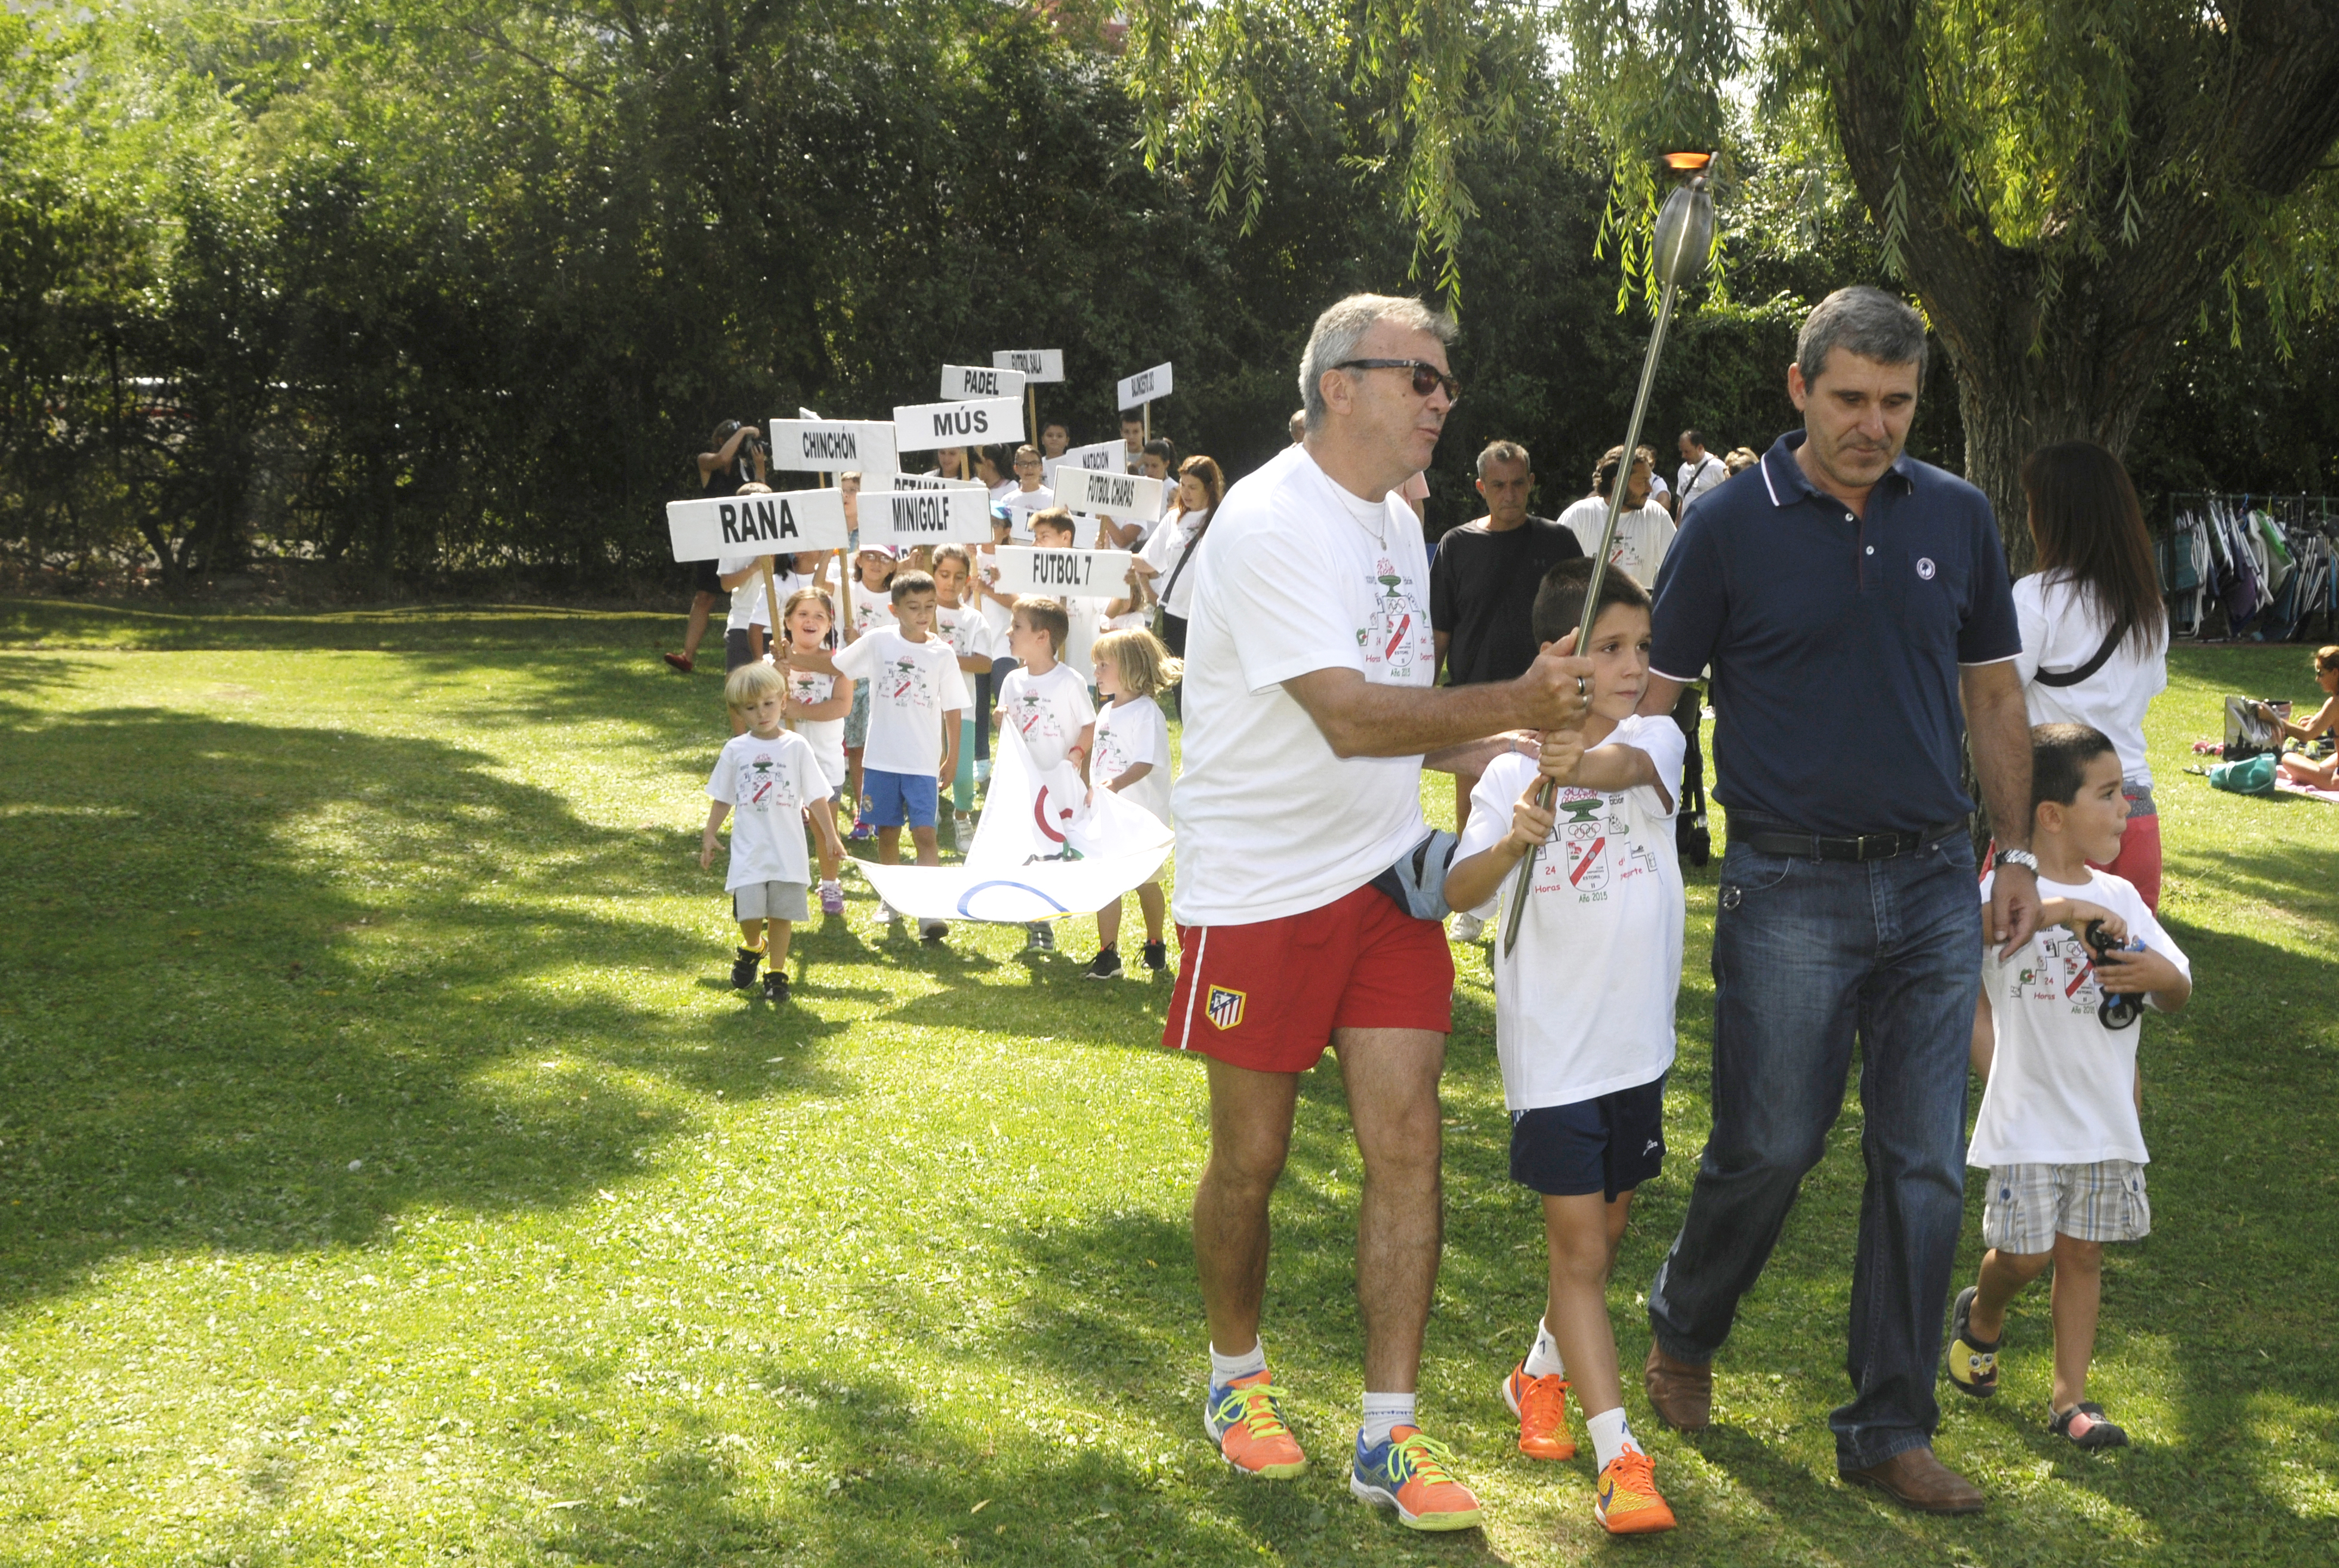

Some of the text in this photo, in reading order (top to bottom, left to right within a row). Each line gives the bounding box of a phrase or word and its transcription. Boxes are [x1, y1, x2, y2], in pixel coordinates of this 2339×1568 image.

[1030, 353, 1042, 374] SALA
[964, 370, 999, 396] PADEL
[933, 406, 989, 437] MÚS
[803, 425, 857, 459] CHINCHÓN
[1082, 446, 1109, 470] NATACIÓN
[1087, 475, 1134, 508] FUTBOL CHAPAS
[719, 499, 798, 544] RANA
[892, 496, 949, 532] MINIGOLF
[1033, 553, 1091, 585] FUTBOL 7
[1545, 865, 1556, 875] 24
[1535, 884, 1561, 894] Horas
[1578, 891, 1608, 903] Año 2015
